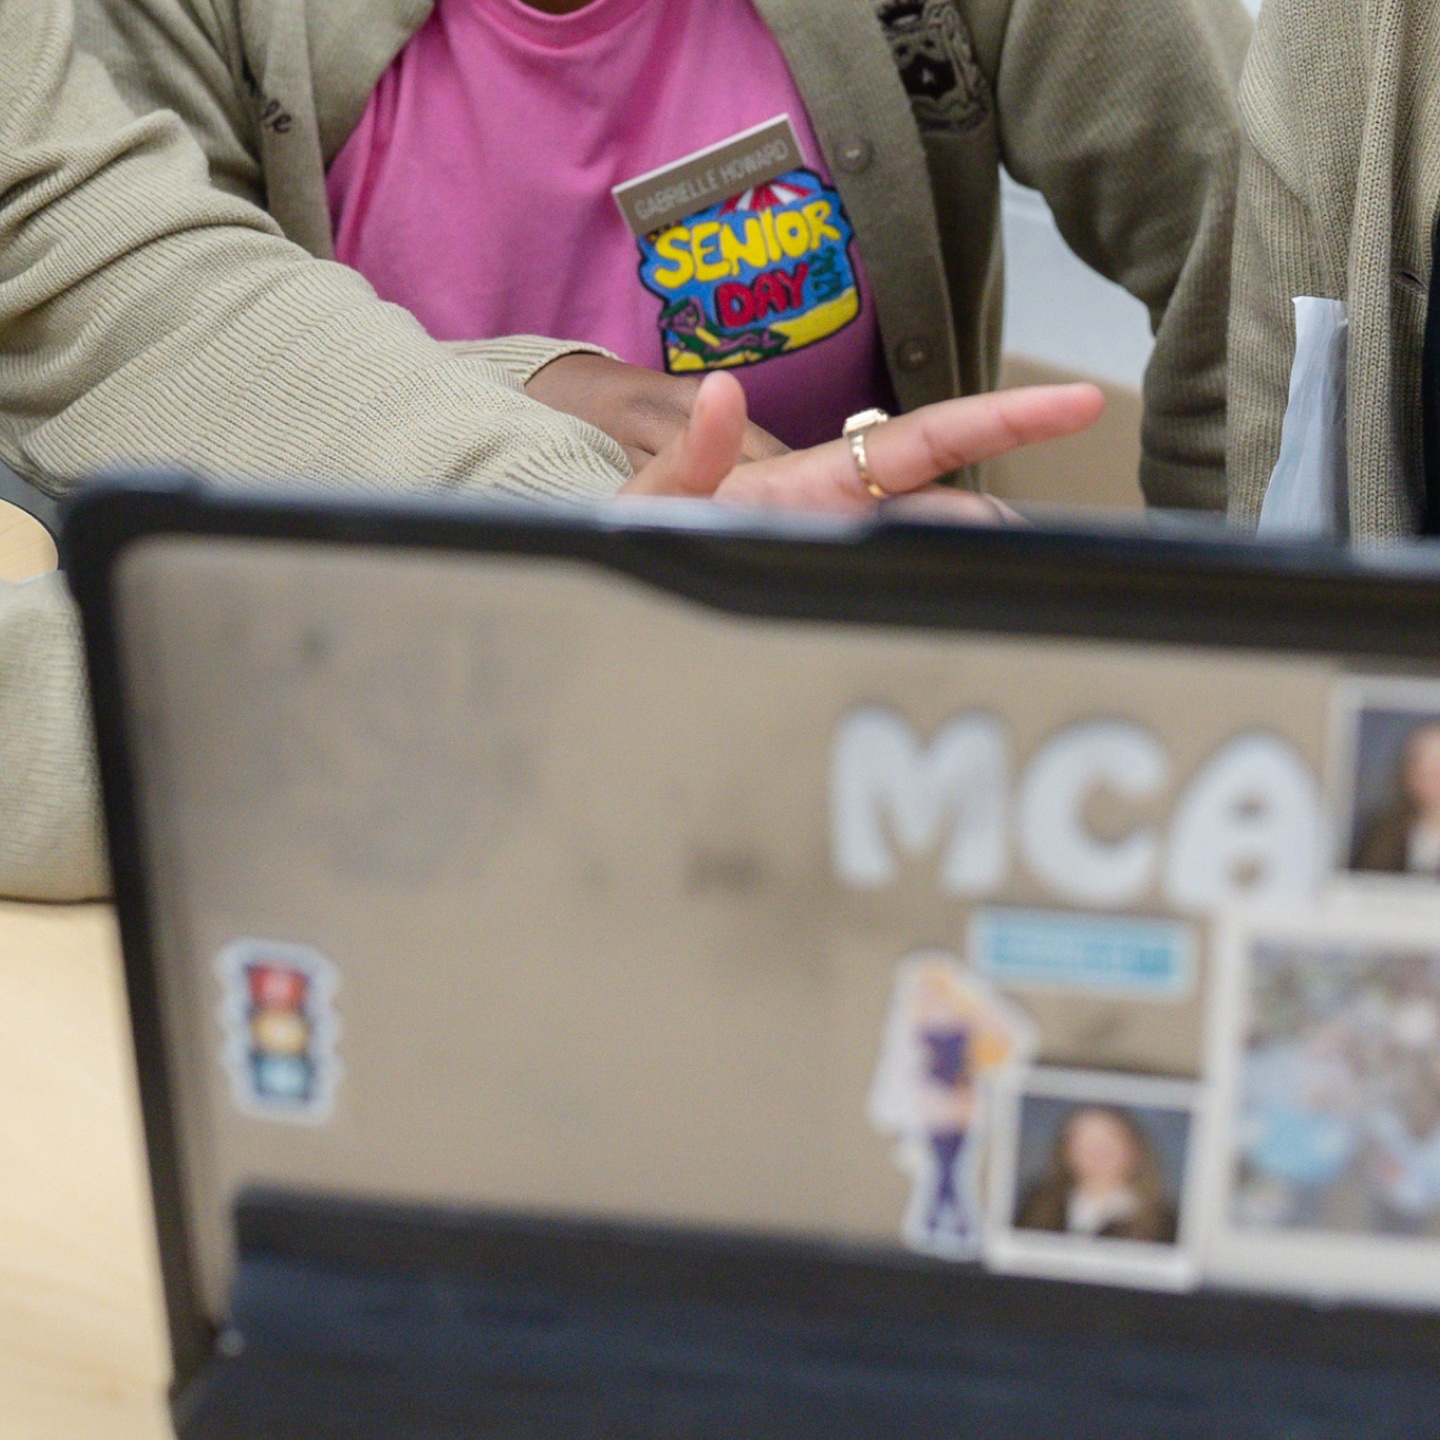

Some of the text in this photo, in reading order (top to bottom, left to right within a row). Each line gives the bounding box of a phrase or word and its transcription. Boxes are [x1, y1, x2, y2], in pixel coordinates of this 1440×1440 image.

[653, 200, 841, 289] SENIOR
[714, 262, 809, 328] DAY
[832, 708, 1326, 908] MCA
